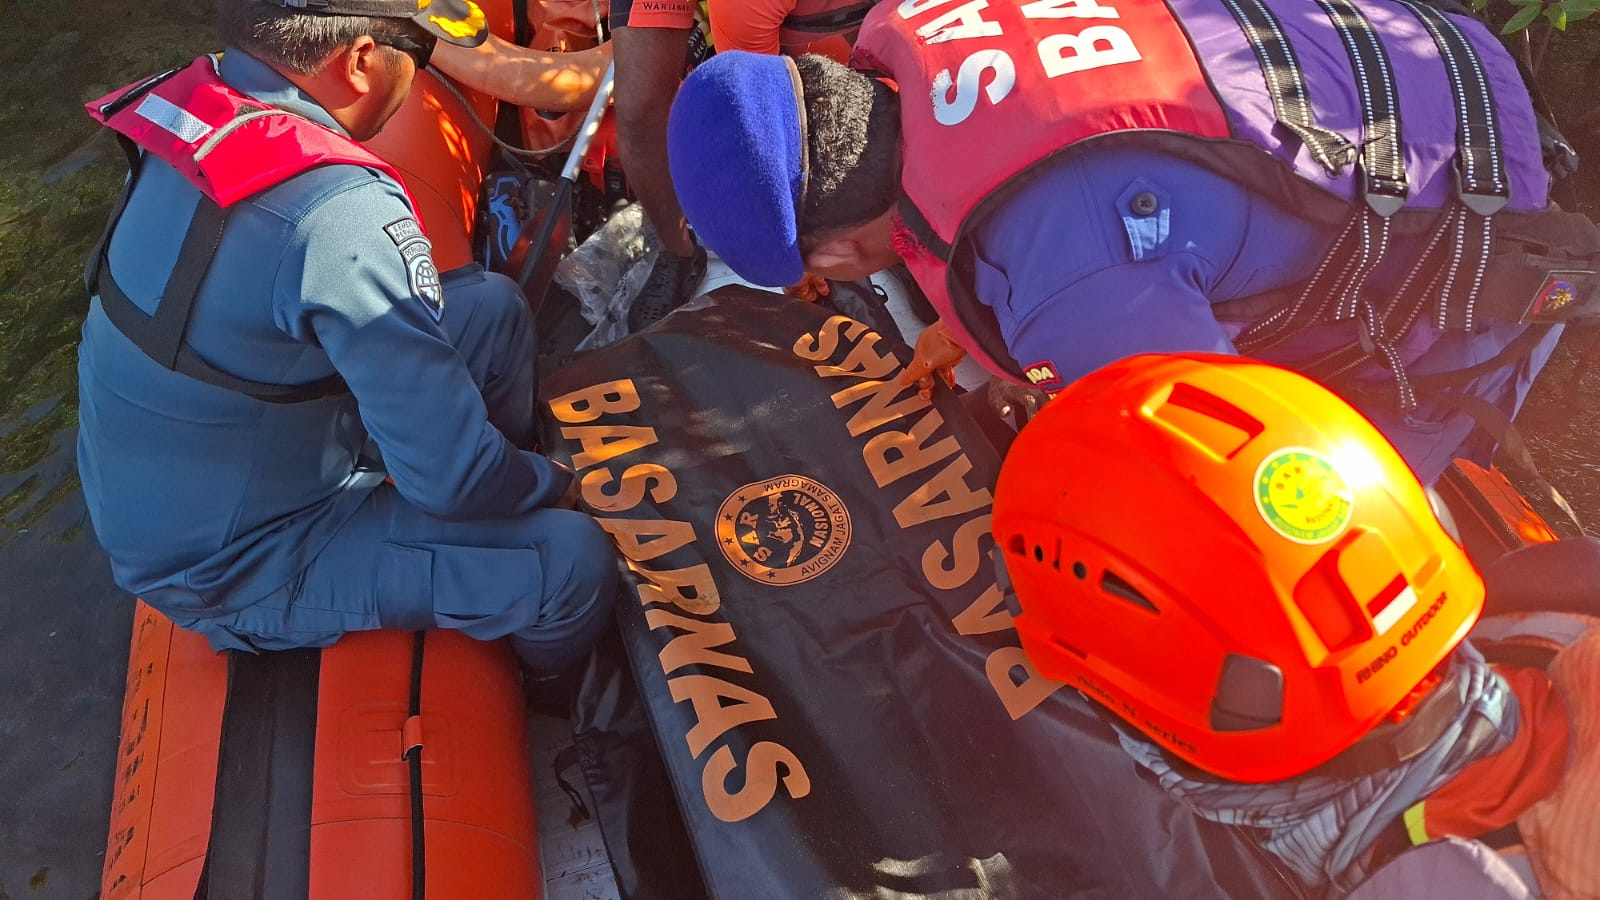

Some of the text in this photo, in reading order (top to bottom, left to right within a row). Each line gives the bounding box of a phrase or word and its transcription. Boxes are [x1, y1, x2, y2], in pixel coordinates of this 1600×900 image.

[740, 511, 773, 561] SAR
[763, 480, 846, 576] AVIGNAM JAGAT SAMAGRAM
[793, 493, 830, 548] NASIONAL
[549, 378, 811, 823] BASARNAS
[1355, 646, 1398, 685] RHINO
